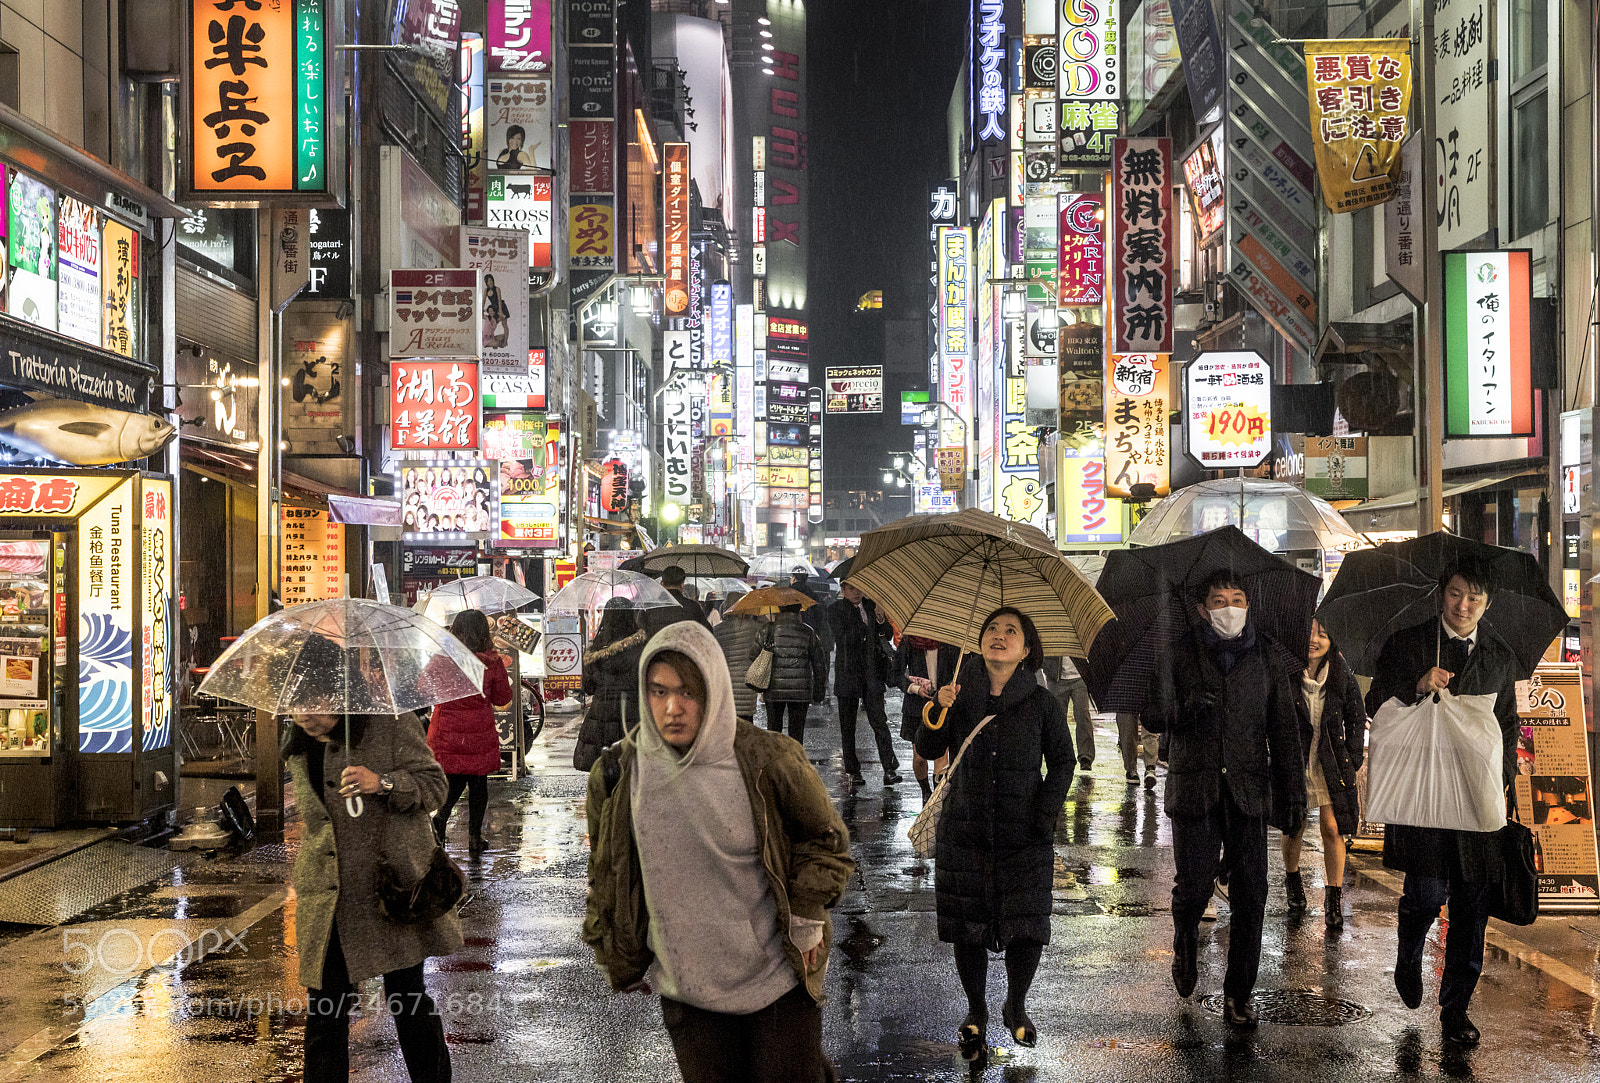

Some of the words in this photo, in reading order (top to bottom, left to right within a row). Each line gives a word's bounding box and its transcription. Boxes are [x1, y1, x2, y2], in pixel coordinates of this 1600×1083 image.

[1453, 4, 1483, 58] 焼酎
[1234, 38, 1248, 51] 7
[500, 51, 547, 71] Eden
[1314, 54, 1403, 82] 悪質な
[1235, 72, 1248, 85] 6
[1441, 59, 1484, 106] 一品料理
[203, 0, 270, 182] 半兵ヱ
[491, 94, 547, 106] マッサージ
[1316, 85, 1403, 113] 客引き
[1061, 101, 1119, 131] 麻雀
[1235, 104, 1249, 117] 5
[1320, 115, 1406, 143] に注意
[1235, 137, 1249, 149] 4
[584, 122, 598, 192] リフレッシュ
[1466, 148, 1483, 185] 2F
[1235, 167, 1248, 182] 3
[491, 180, 502, 191] 肉
[1062, 195, 1074, 204] 3F
[1235, 200, 1248, 214] 2
[490, 208, 549, 222] XROSS
[1123, 147, 1164, 342] 無料案内所
[1071, 234, 1084, 297] カリーナ
[1233, 262, 1252, 281] B1
[425, 275, 444, 284] 2F
[571, 281, 590, 295] Party
[414, 290, 473, 306] タイ古式
[946, 235, 967, 354] まんが喫茶
[396, 307, 473, 323] マッサージ
[713, 285, 730, 348] カラオケ
[769, 322, 807, 335] 全店営業中
[1066, 347, 1100, 355] Walton's
[1476, 292, 1501, 415] 俺のイタリアン
[9, 350, 67, 388] Trattoria
[69, 366, 114, 400] Pizzeria
[117, 382, 136, 405] Bar
[396, 363, 474, 407] 湖南
[1115, 364, 1154, 386] 新宿
[490, 381, 535, 394] CASA
[1128, 384, 1142, 394] の
[412, 409, 474, 447] 菜館
[1208, 409, 1264, 436] 190円
[1113, 398, 1143, 487] まっちゃん
[771, 473, 794, 483] ゲーム
[0, 478, 78, 512] 商店
[1081, 460, 1106, 531] クラウン
[110, 505, 122, 535] Tuna
[286, 509, 320, 518] ねぎタン
[90, 525, 103, 598] 金枪鱼餐厅
[446, 551, 476, 567] Eden
[110, 538, 122, 610] Restaurant
[544, 681, 582, 690] COFFEE
[1520, 718, 1570, 726] う大人の隠れ家
